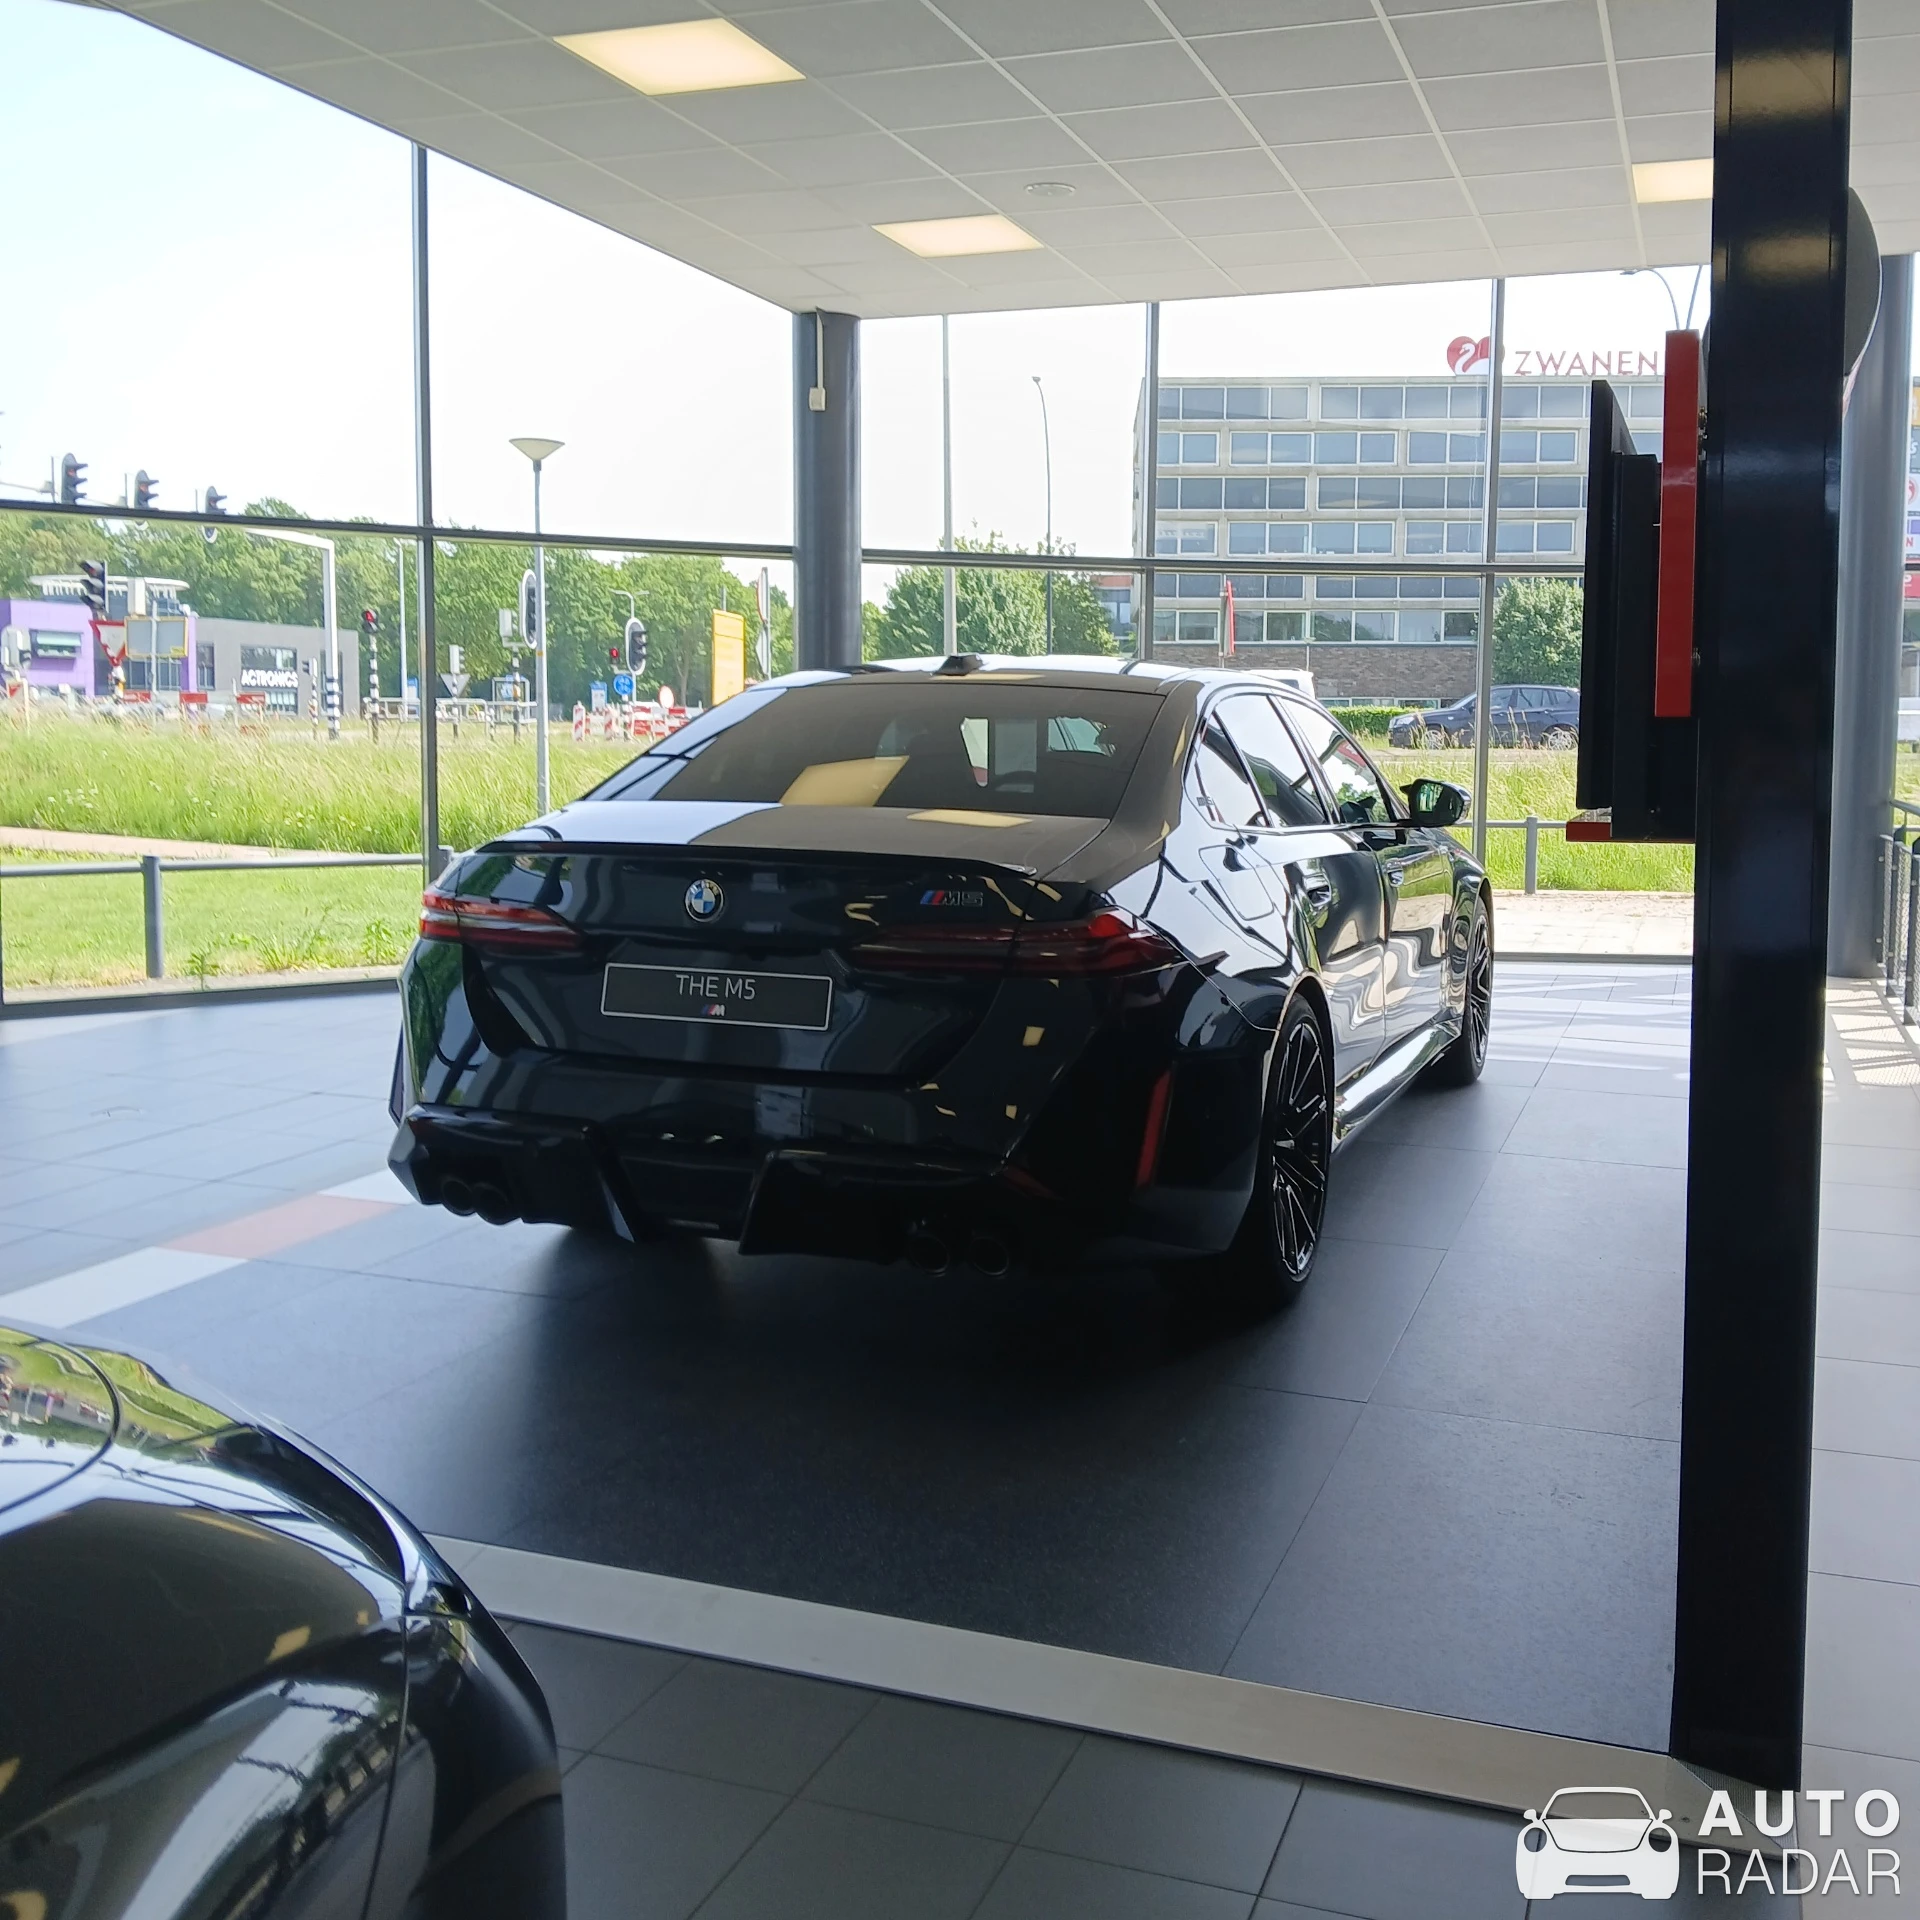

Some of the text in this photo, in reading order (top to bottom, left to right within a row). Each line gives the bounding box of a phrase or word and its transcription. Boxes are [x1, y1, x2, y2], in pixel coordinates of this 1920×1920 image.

[1515, 351, 1658, 376] ZWANEN
[241, 669, 299, 688] ACTRONICS
[675, 974, 756, 1000] THE M5
